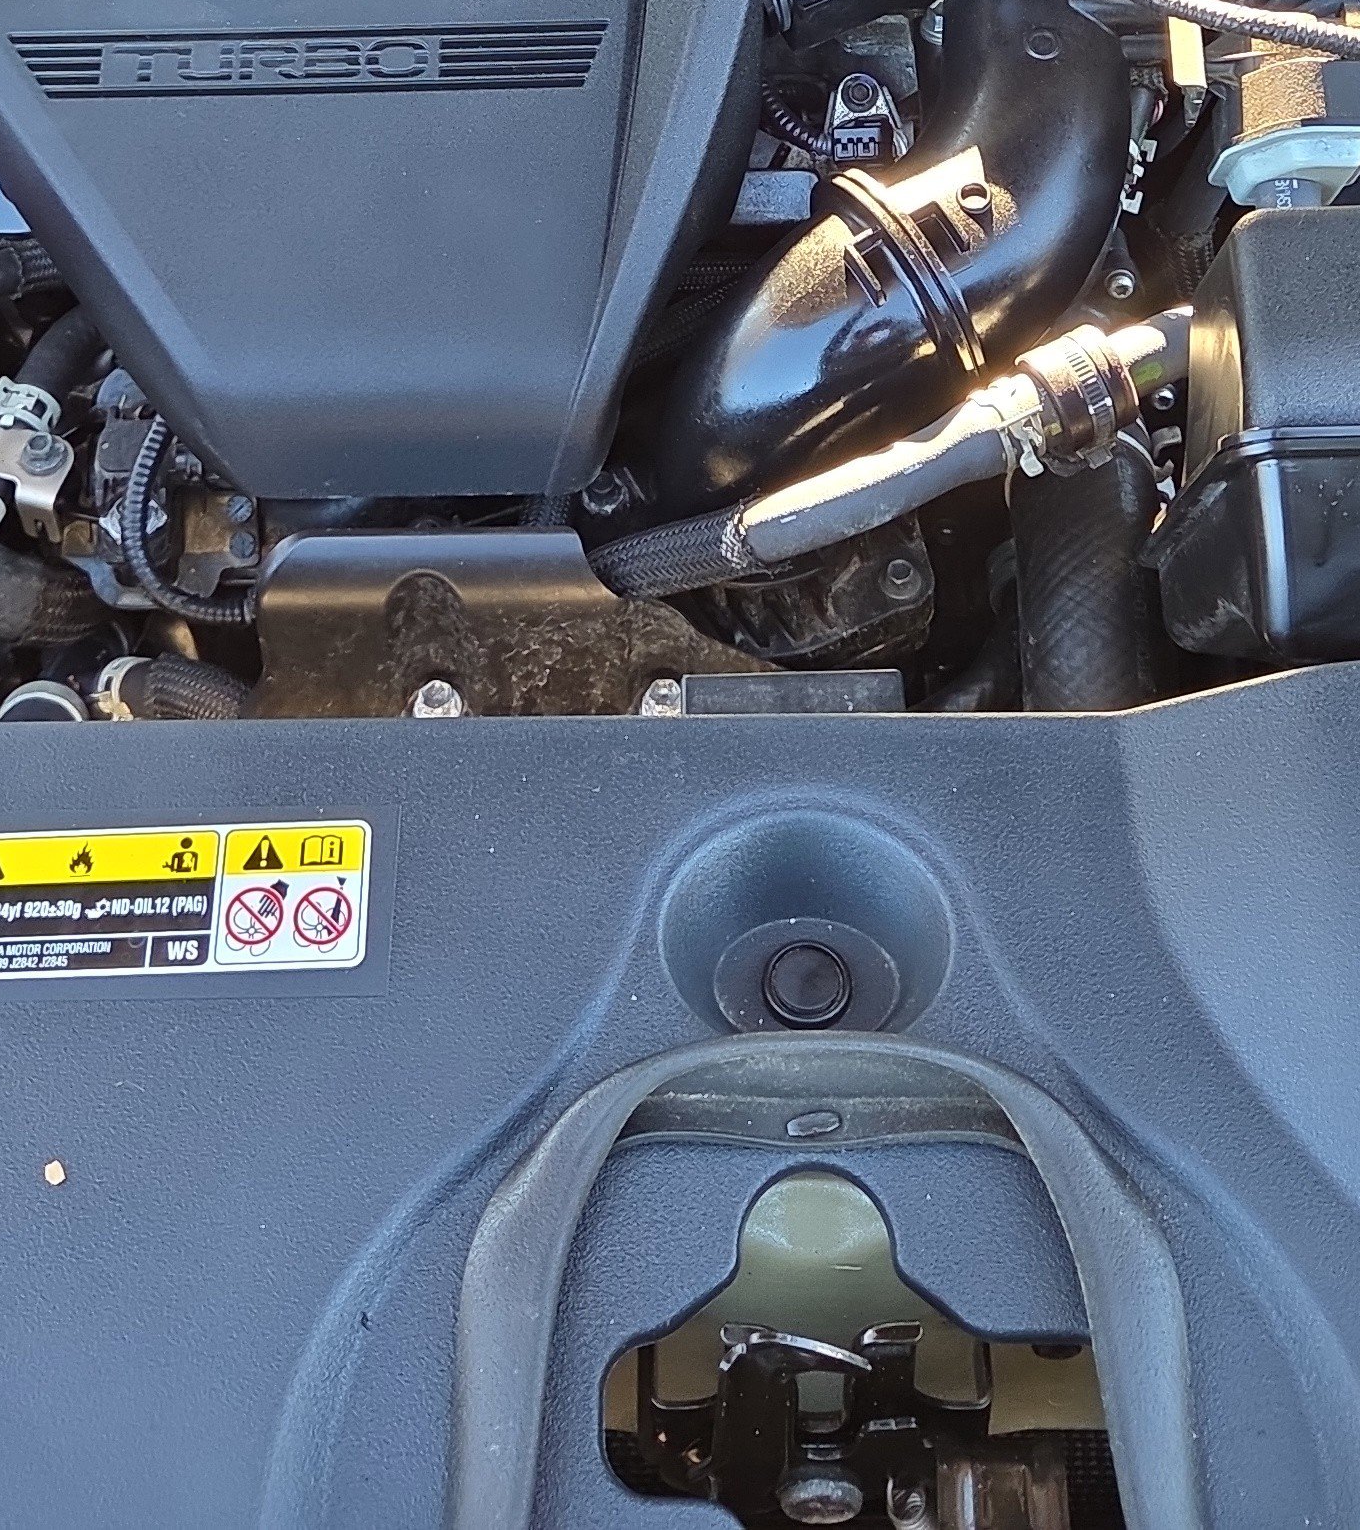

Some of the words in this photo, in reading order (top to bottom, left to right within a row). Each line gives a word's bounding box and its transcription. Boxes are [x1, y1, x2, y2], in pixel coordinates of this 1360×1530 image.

[112, 36, 433, 83] TURBO
[24, 900, 82, 920] 920±30g
[172, 895, 208, 917] (PAG)
[5, 943, 42, 956] MOTOR
[42, 940, 113, 955] CORPORATION
[166, 939, 200, 961] WS
[9, 956, 39, 969] J2842
[38, 955, 69, 968] J2845
